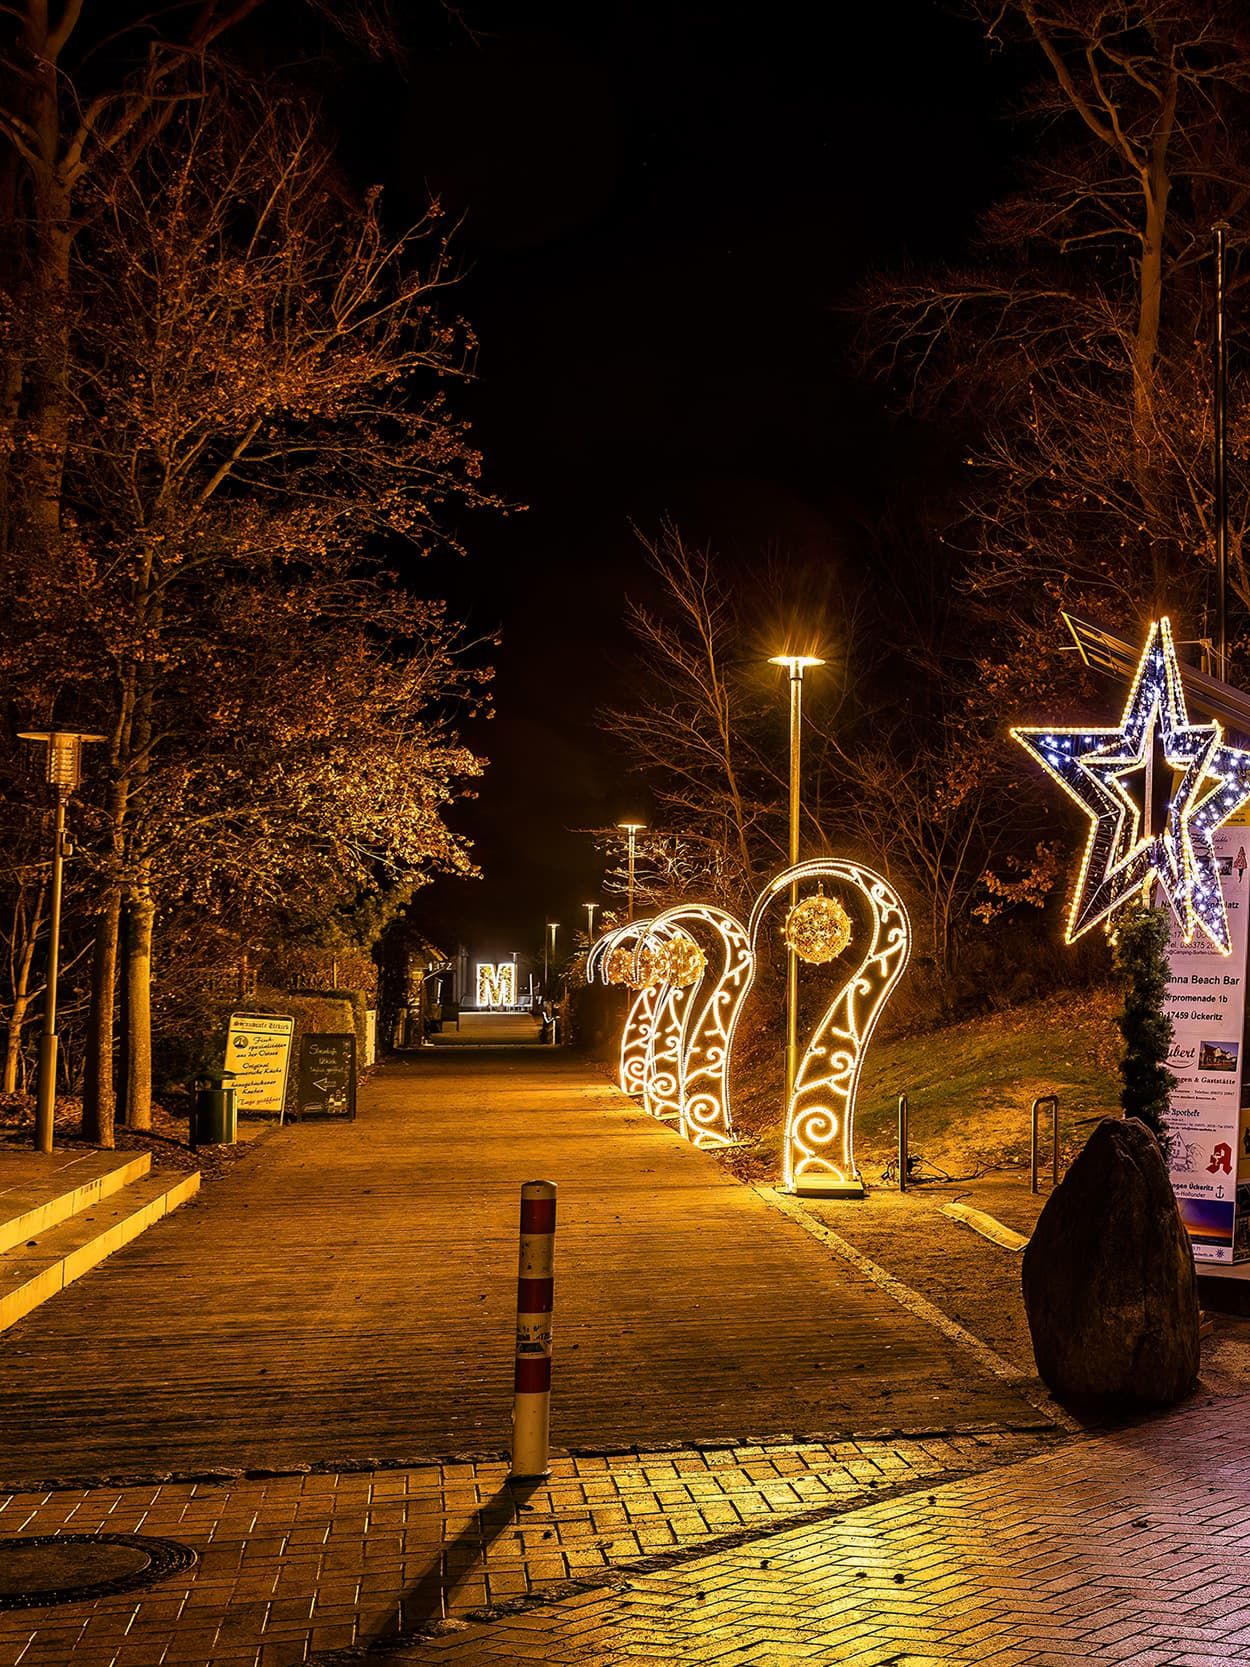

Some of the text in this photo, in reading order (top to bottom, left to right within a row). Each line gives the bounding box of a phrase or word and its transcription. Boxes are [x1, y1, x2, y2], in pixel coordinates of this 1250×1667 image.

[476, 963, 515, 1008] M
[1191, 975, 1220, 985] Beach
[1223, 975, 1240, 985] Bar
[1218, 994, 1228, 1003] 1b
[1190, 1010, 1223, 1022] Ückeritz
